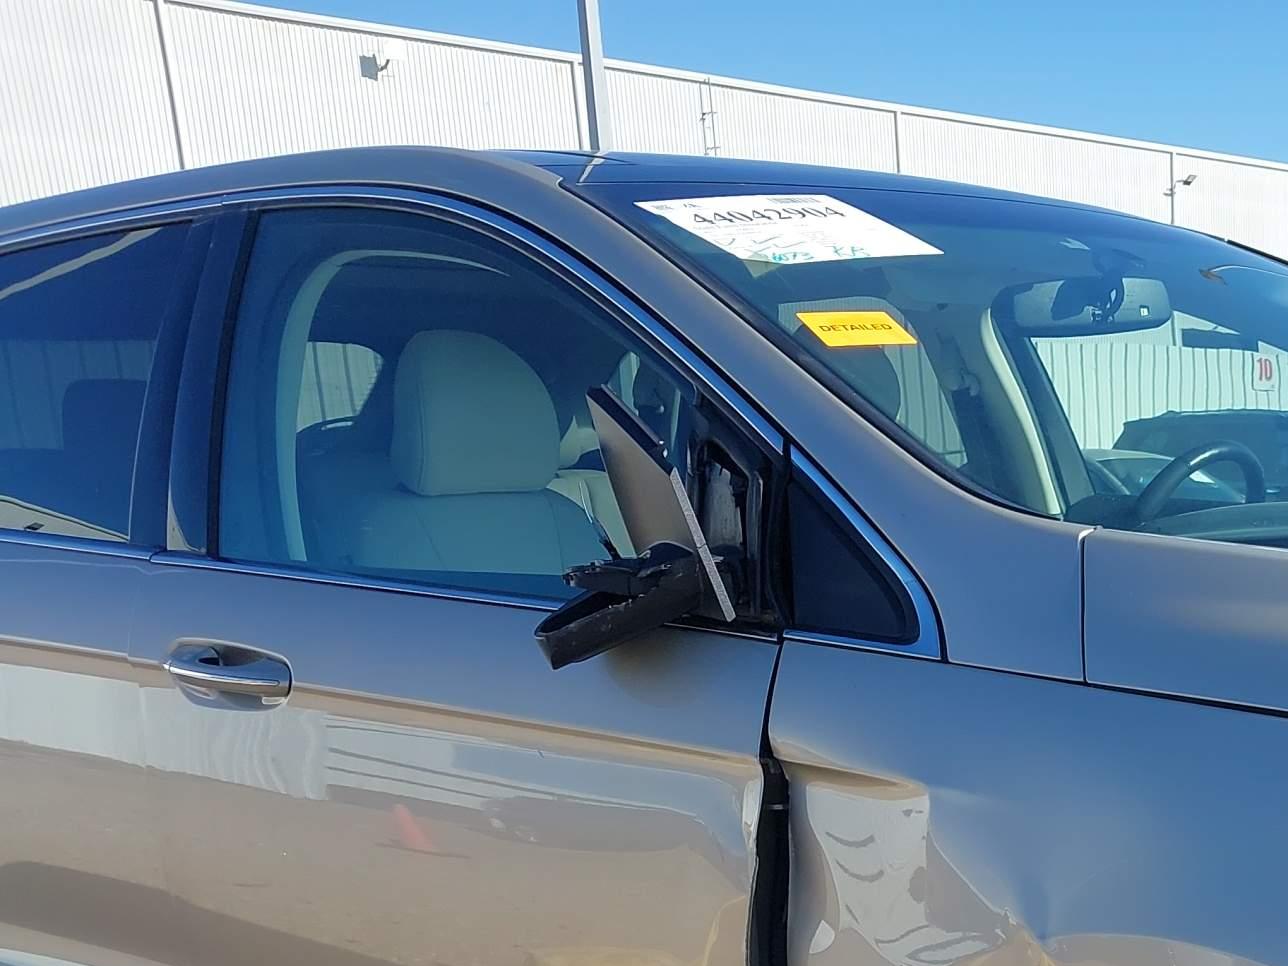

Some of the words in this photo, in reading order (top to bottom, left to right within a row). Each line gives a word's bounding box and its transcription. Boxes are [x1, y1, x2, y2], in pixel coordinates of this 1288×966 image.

[693, 206, 846, 225] 44042904
[818, 323, 893, 332] DETAILED
[1256, 358, 1273, 381] 10
